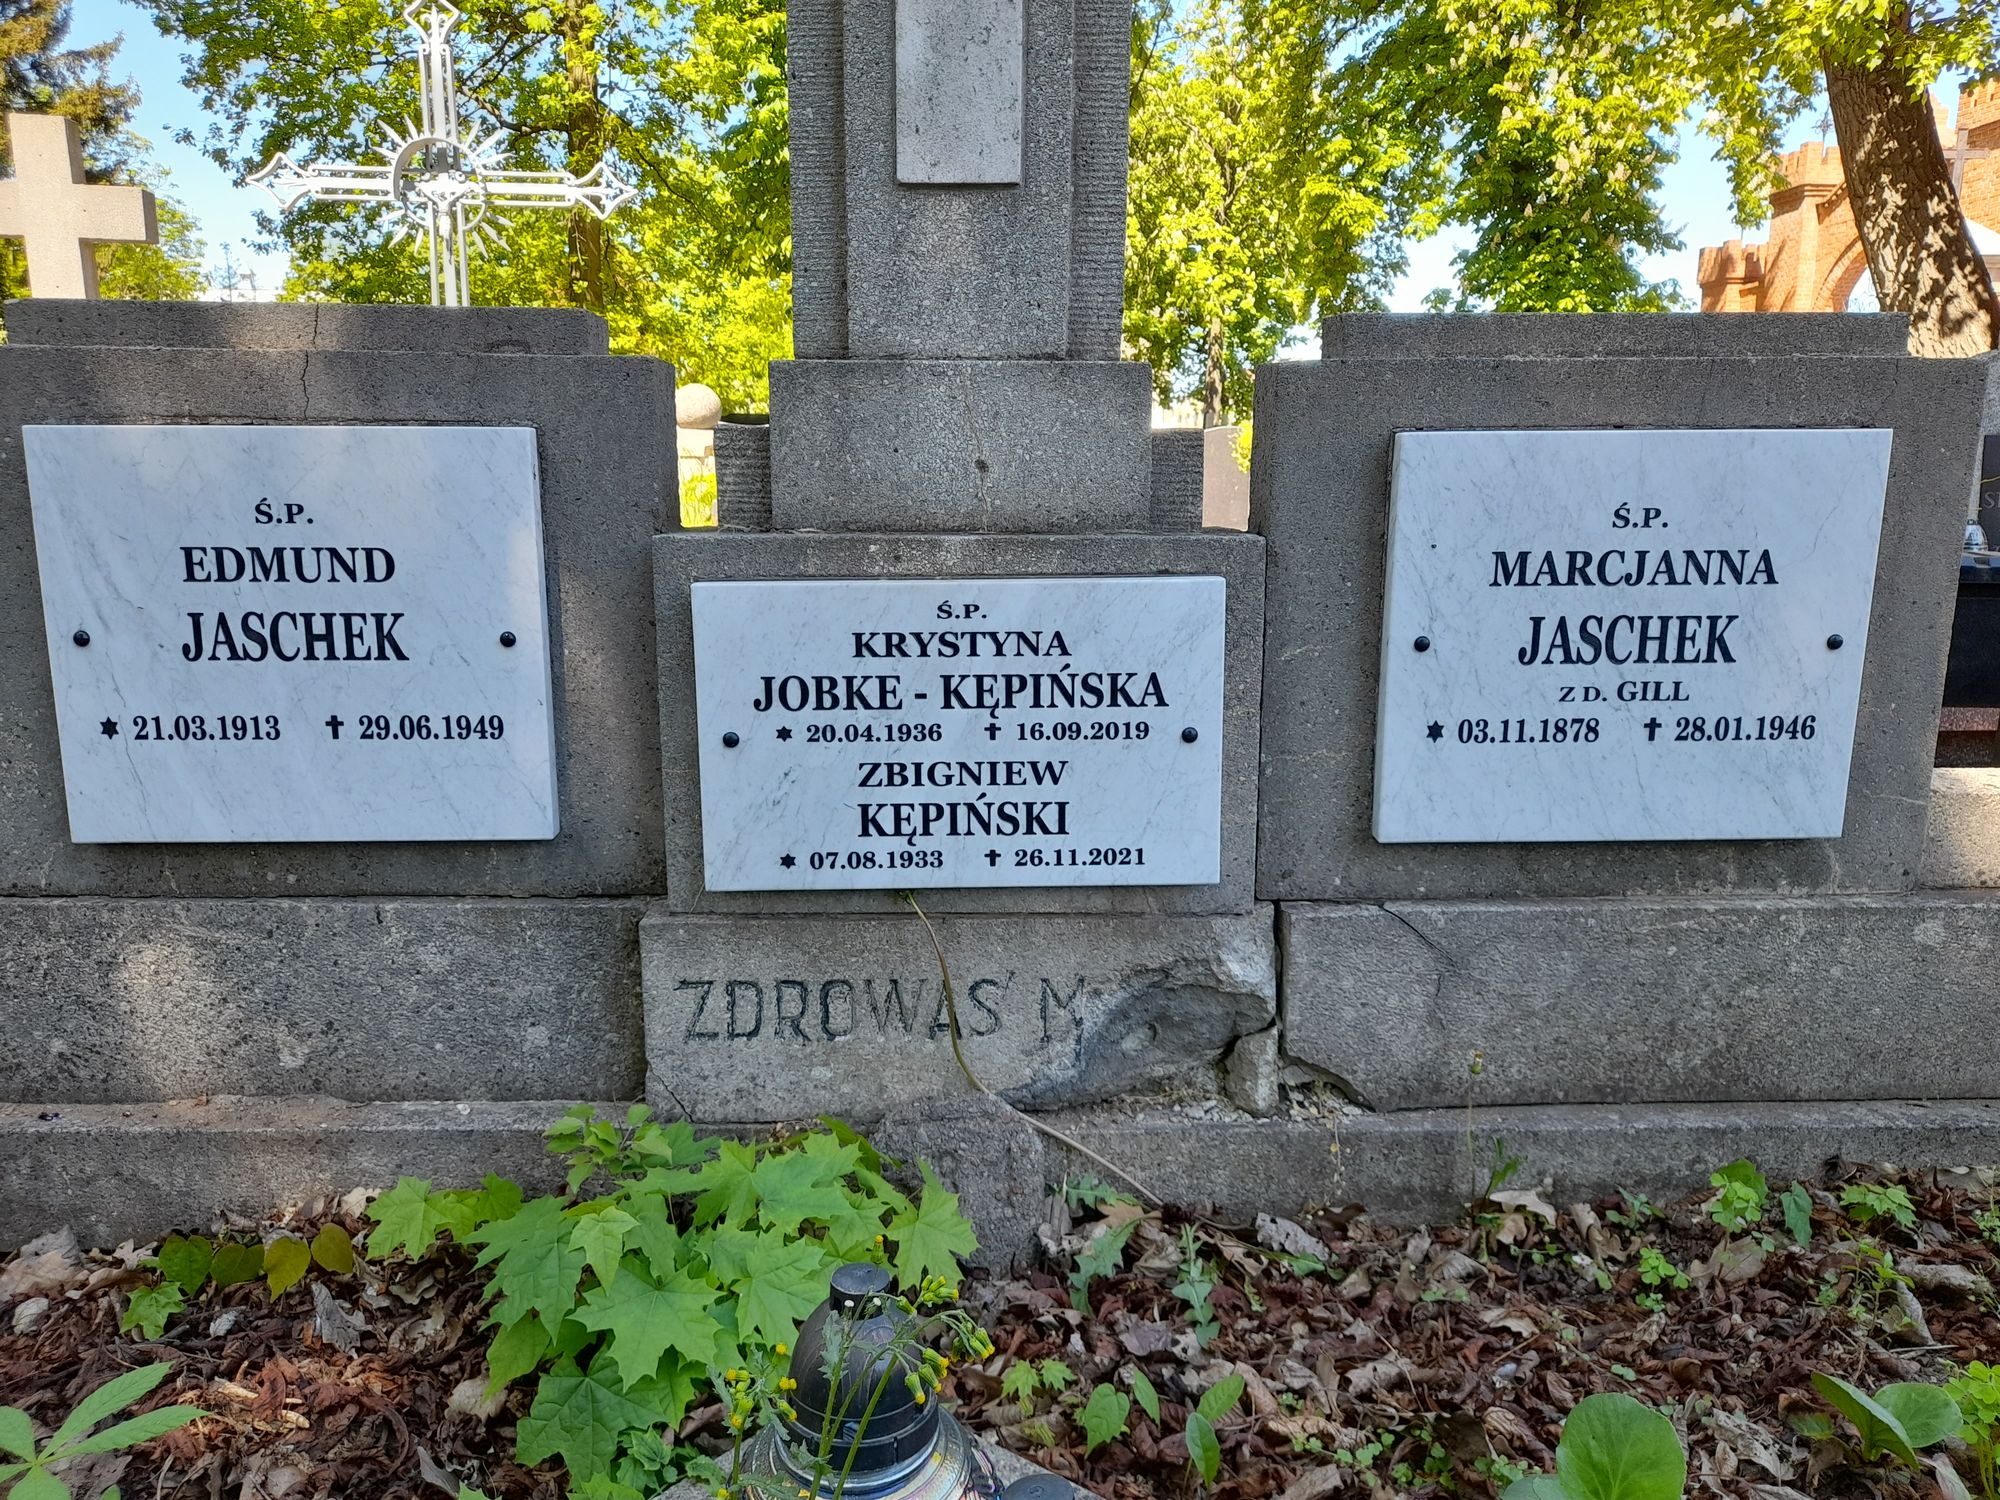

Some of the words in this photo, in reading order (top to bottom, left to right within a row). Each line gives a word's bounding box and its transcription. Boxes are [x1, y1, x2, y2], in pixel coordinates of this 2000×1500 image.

[254, 497, 314, 525] Ś.P.
[1612, 501, 1669, 529] Ś.P.
[179, 546, 396, 584] EDMUND
[1488, 548, 1779, 587] MARCJANNA
[936, 599, 987, 620] Ś.P.
[181, 611, 410, 663] JASCHEK
[851, 630, 1073, 658] KRYSTYNA
[1517, 614, 1740, 666] JASCHEK
[753, 674, 903, 713] JOBKE
[939, 663, 1170, 719] KĘPIŃSKA
[1616, 680, 1690, 702] GILL
[132, 714, 281, 741] 21.03.1913
[358, 714, 505, 741] 29.06.1949
[806, 722, 943, 743] 20.04.1936
[1016, 721, 1150, 741] 16.09.2019
[1457, 717, 1600, 744] 03.11.1878
[1674, 714, 1817, 742] 28.01.1946
[857, 760, 1069, 788] ZBIGNIEW
[857, 793, 1070, 846] KĘPIŃSKI
[809, 849, 944, 871] 07.08.1933
[1014, 847, 1146, 867] 26.11.2021
